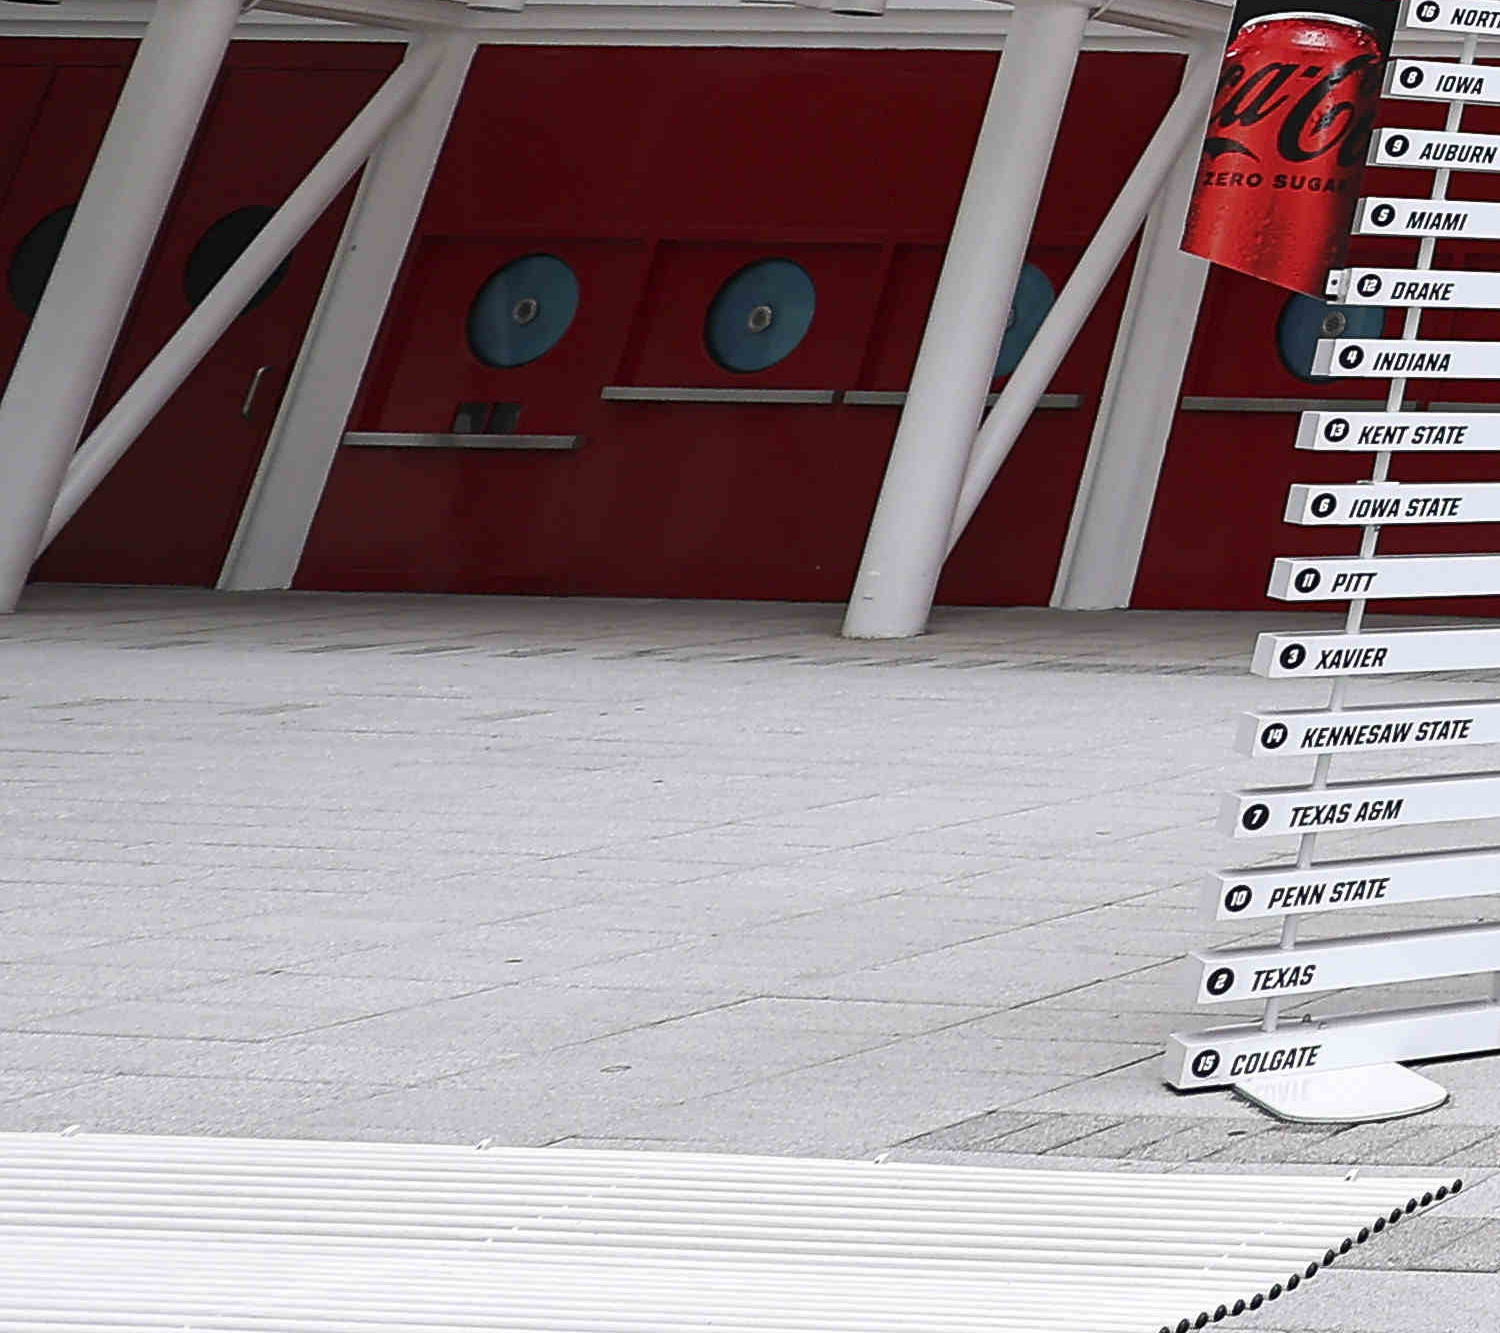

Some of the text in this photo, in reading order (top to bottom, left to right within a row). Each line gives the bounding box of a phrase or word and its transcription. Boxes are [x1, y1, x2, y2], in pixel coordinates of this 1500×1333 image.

[1436, 75, 1483, 94] IOWA
[1419, 143, 1497, 163] AUBURN
[1203, 173, 1262, 188] ZERO
[1406, 212, 1467, 230] MIAMI
[1391, 282, 1454, 300] DRAKE
[1373, 353, 1450, 371] INDIANA
[1358, 426, 1409, 444] KENT
[1411, 426, 1468, 444] STATE
[1349, 498, 1462, 518] IOWA STATE
[1331, 573, 1377, 592] PITT
[1315, 648, 1387, 669] XAVIER
[1301, 723, 1413, 748] KENNESAW
[1415, 719, 1473, 741] STATE
[1290, 799, 1403, 827] TEXAS A&M
[1268, 884, 1324, 909] PENN
[1329, 878, 1390, 902] STATE
[1252, 965, 1315, 991] TEXAS
[1230, 1045, 1321, 1076] COLGATE
